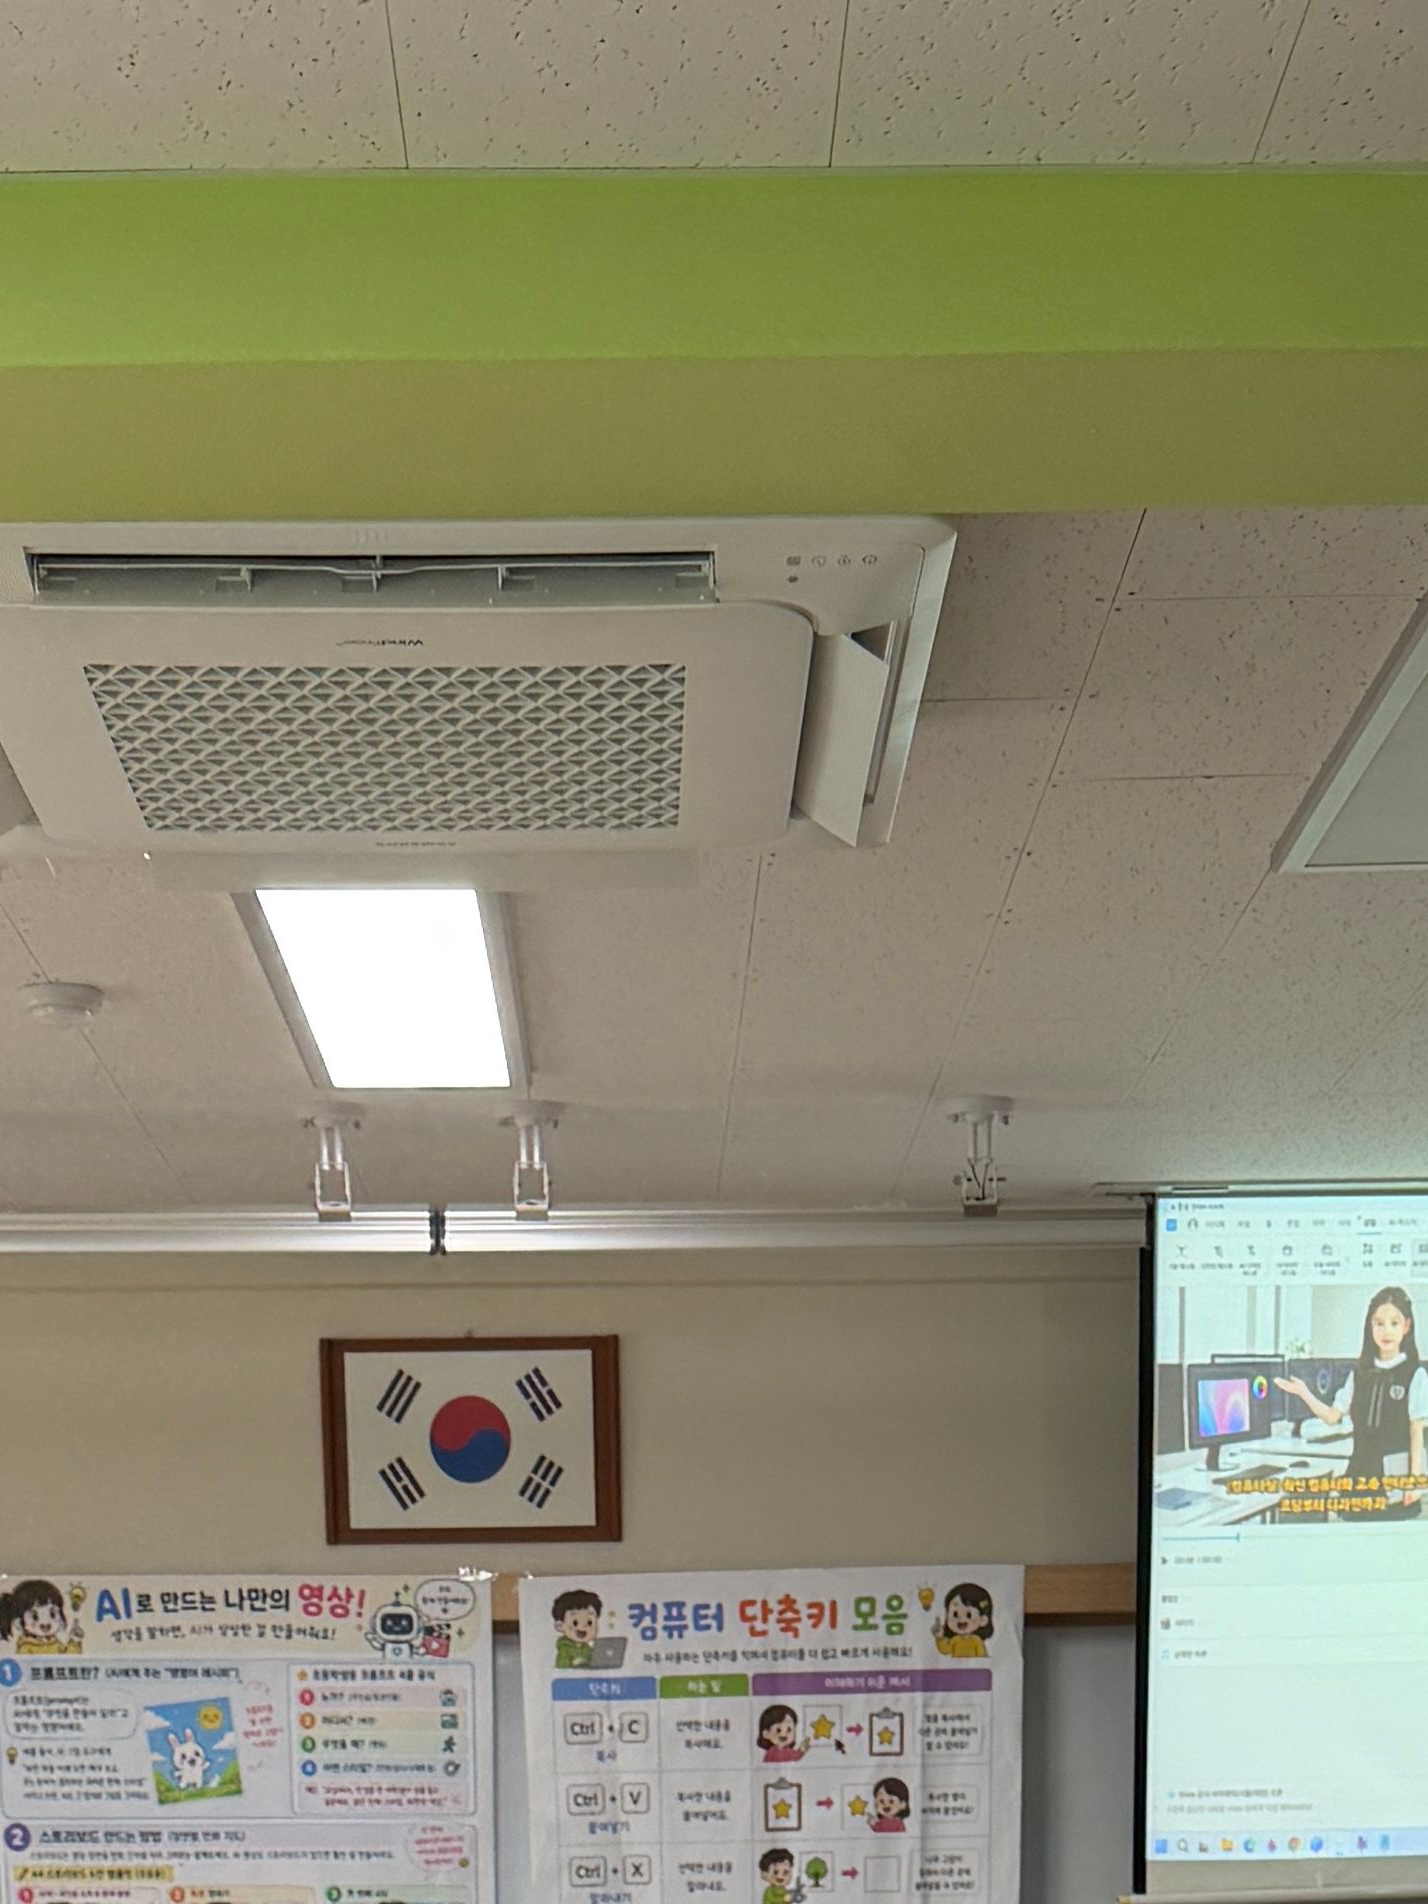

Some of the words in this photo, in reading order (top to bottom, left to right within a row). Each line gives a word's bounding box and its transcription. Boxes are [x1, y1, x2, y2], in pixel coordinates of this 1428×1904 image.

[95, 1586, 154, 1623] AI로
[160, 1590, 217, 1613] 만드는
[224, 1587, 290, 1613] 나만의
[297, 1583, 366, 1619] 영상!
[628, 1601, 725, 1641] 컴퓨터
[738, 1593, 838, 1639] 단축키
[851, 1594, 909, 1636] 모음
[570, 1722, 596, 1737] Ctrl
[627, 1719, 639, 1735] C
[573, 1793, 599, 1807] Ctrl
[629, 1791, 643, 1805] V
[575, 1865, 601, 1879] Ctrl
[630, 1862, 644, 1877] X
